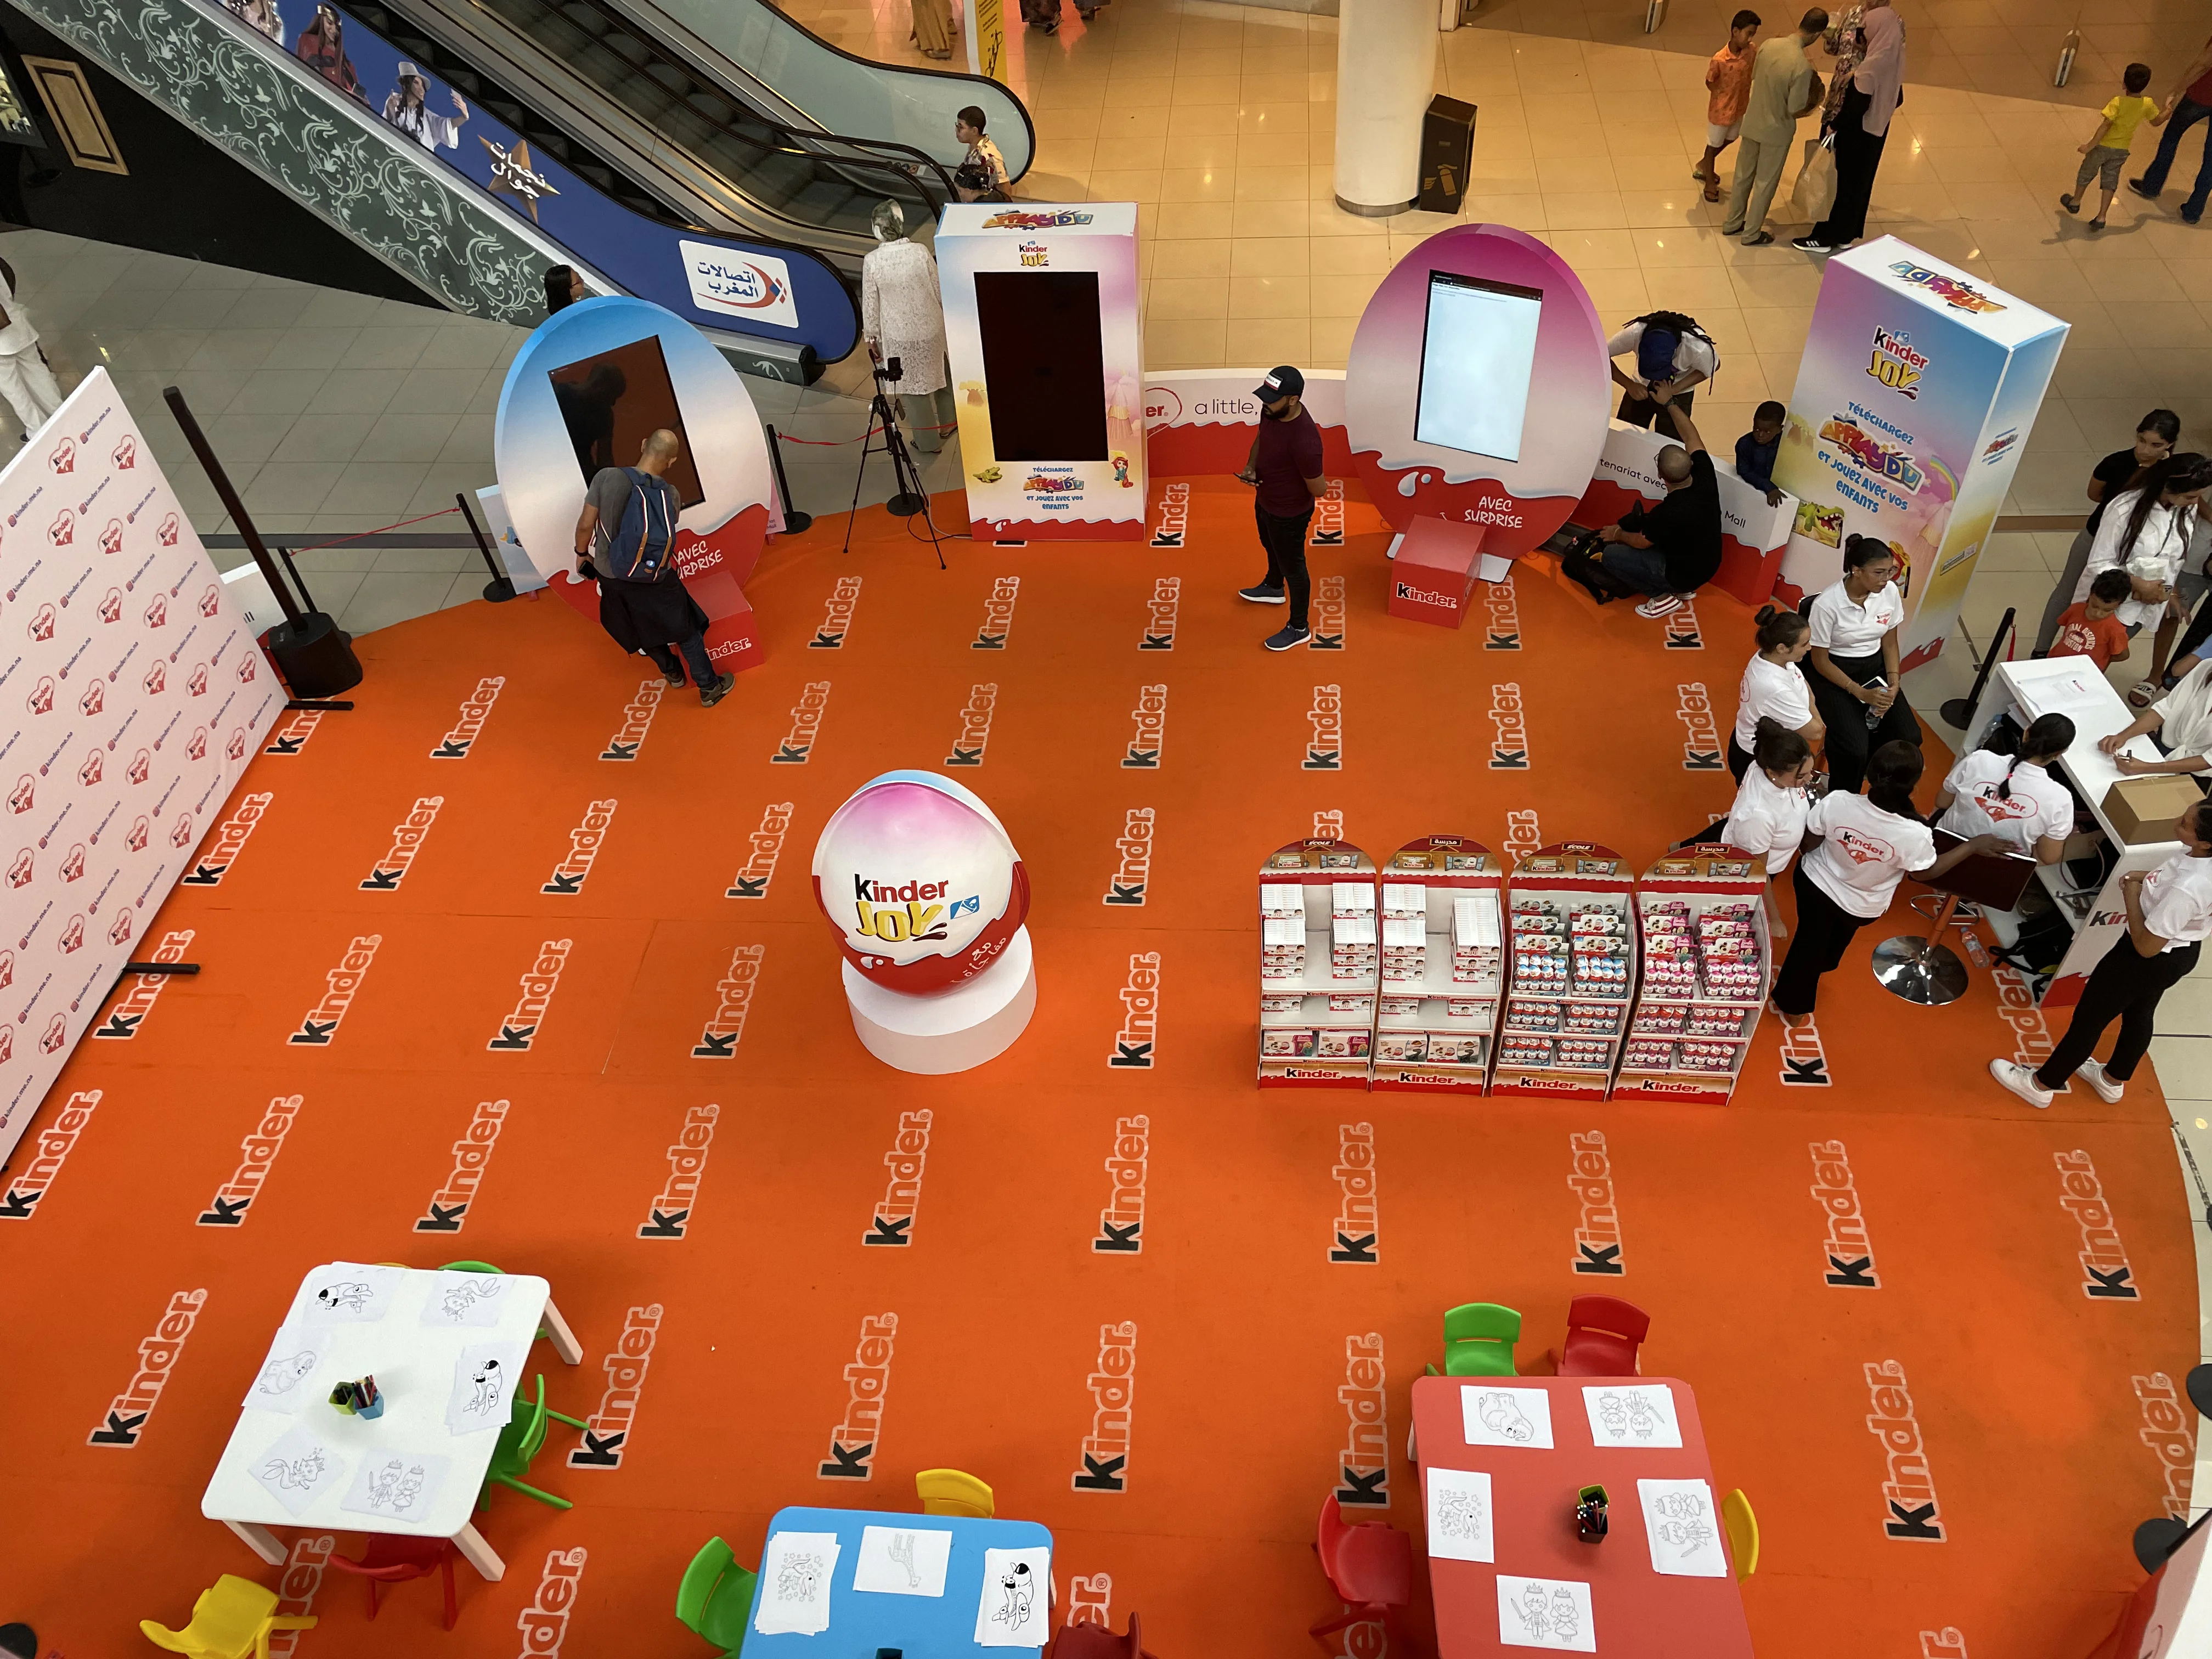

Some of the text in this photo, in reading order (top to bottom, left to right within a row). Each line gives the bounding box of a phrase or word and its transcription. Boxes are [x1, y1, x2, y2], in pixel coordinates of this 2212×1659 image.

[1020, 253, 1047, 266] JOY
[698, 262, 755, 284] اتصالات
[708, 281, 759, 297] المغرب
[1866, 349, 1921, 390] JOY
[1195, 399, 1258, 415] a little,
[1479, 496, 1513, 512] AVEC
[1464, 509, 1523, 528] SURPRISE
[1725, 510, 1746, 528] Mall
[678, 540, 708, 565] AVEC
[856, 901, 944, 943] JOY
